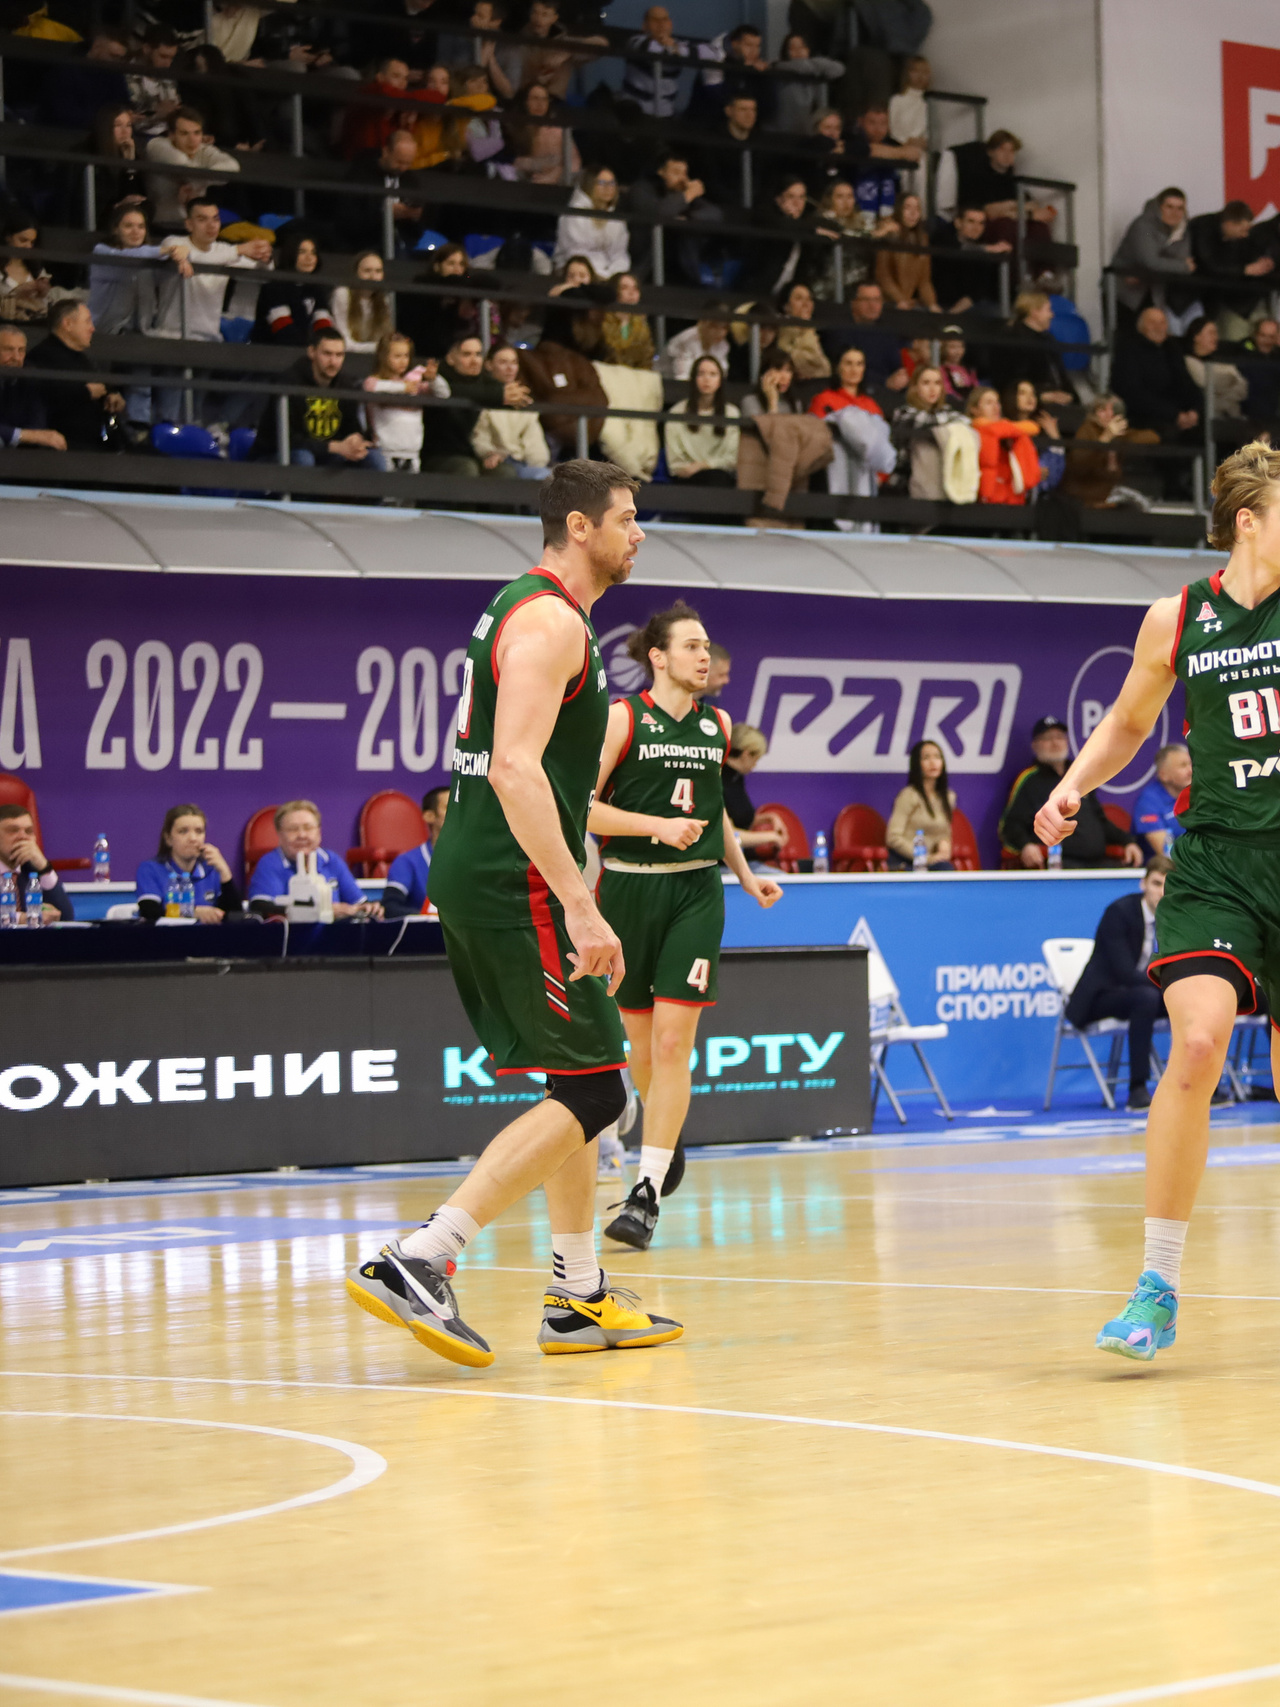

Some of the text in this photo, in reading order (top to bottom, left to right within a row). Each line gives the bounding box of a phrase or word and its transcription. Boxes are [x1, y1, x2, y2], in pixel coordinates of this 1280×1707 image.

[764, 674, 1007, 757] PARI
[638, 744, 724, 765] ЛОКОМОТИВ
[664, 761, 706, 770] КУБАНЬ
[670, 778, 695, 814] 4
[686, 957, 711, 994] 4
